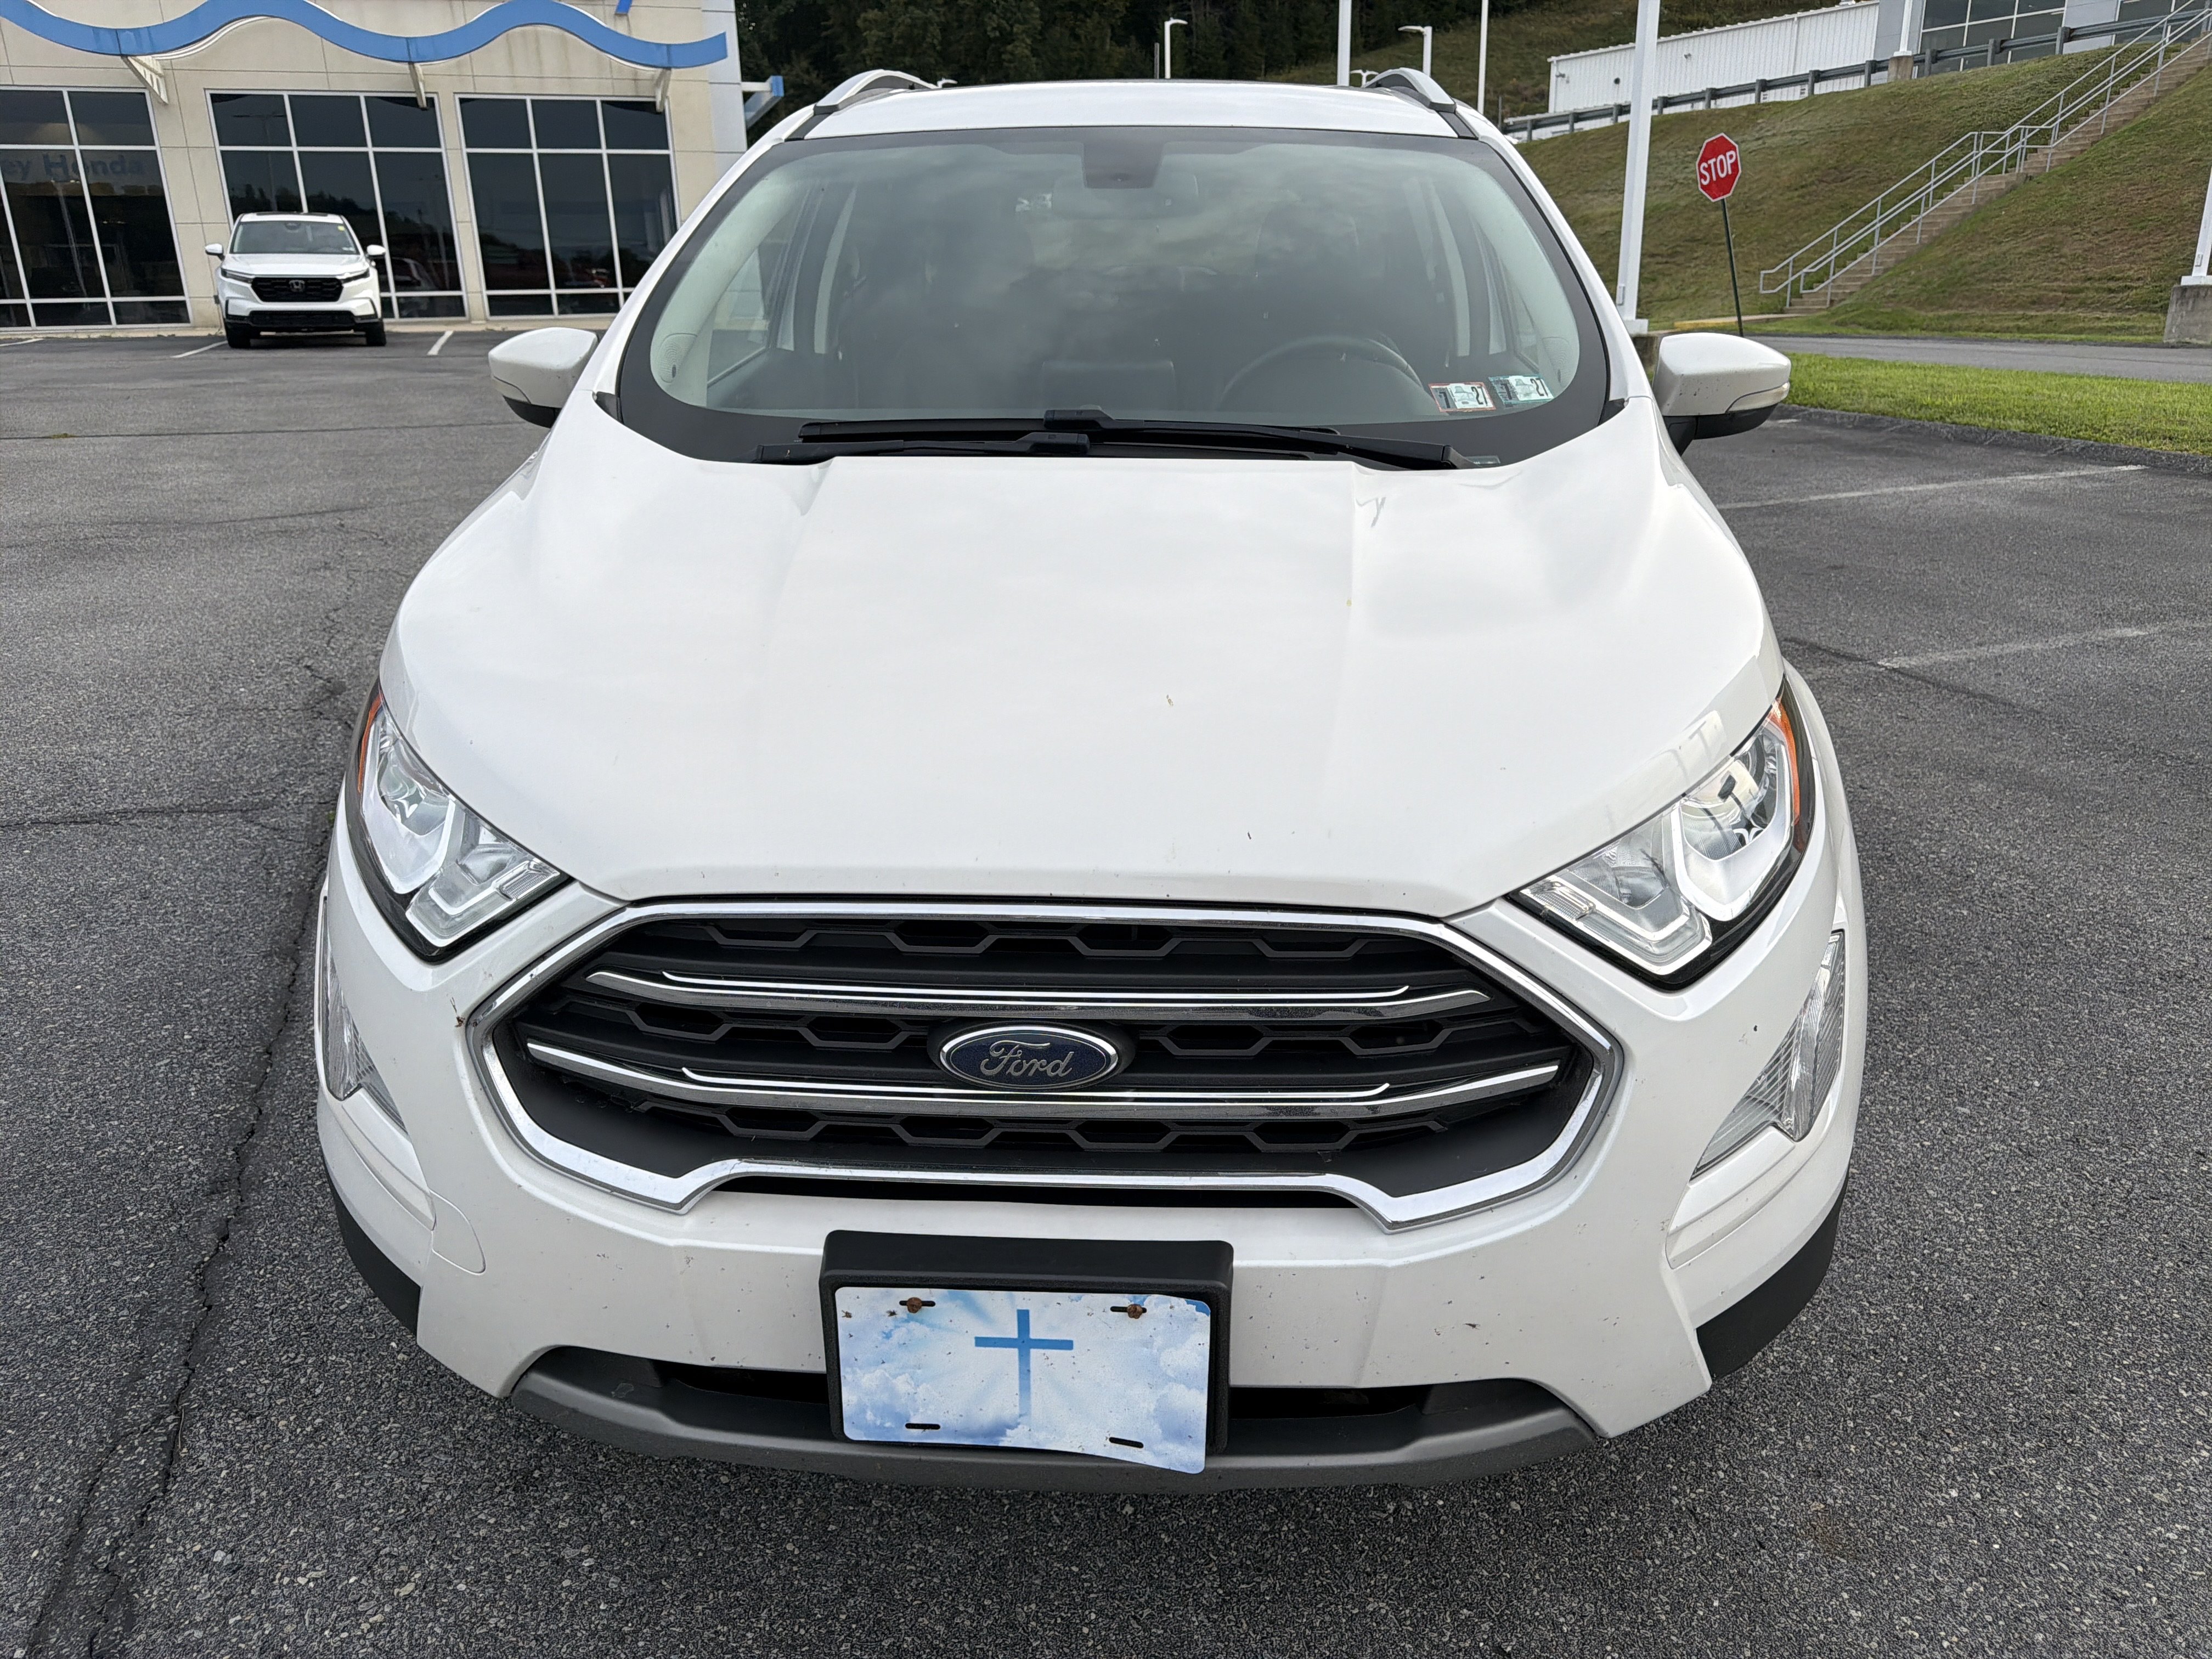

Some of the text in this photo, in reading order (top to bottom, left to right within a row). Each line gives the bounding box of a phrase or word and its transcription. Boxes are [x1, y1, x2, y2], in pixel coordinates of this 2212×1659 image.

[1700, 150, 1736, 185] STOP
[1471, 386, 1488, 407] 27
[1530, 377, 1549, 396] 27
[980, 1040, 1075, 1077] Ford
